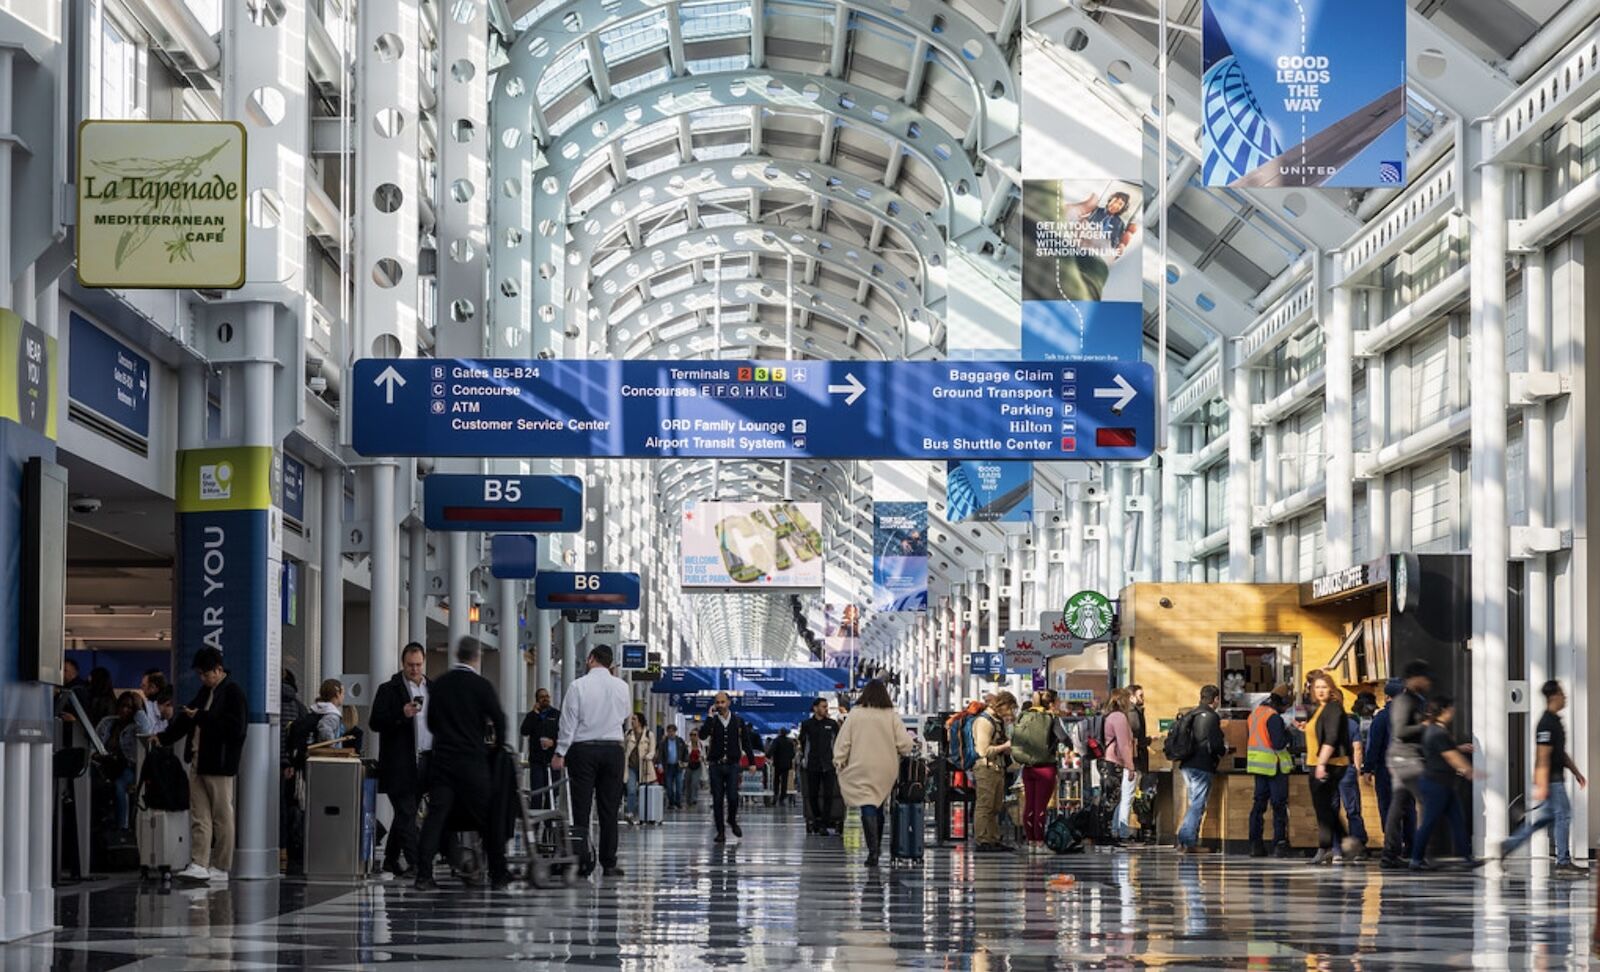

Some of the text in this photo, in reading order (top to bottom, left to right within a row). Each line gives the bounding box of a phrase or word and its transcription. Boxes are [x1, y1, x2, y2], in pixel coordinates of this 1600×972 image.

[1276, 56, 1329, 69] GOOD
[1276, 70, 1331, 83] LEADS
[1287, 84, 1319, 97] THE
[1283, 98, 1323, 112] WAY
[1279, 166, 1338, 175] UNITED
[84, 174, 238, 209] La Tapenade
[94, 215, 224, 225] MEDITERRANEAN
[1036, 221, 1102, 231] GET IN TOUCH
[185, 227, 226, 242] CAFÉ
[1036, 230, 1112, 239] WITH AN AGENT
[1036, 239, 1081, 248] WITHOUT
[1036, 248, 1121, 257] STANDING IN LINE
[434, 367, 540, 379] B Gates B5-B24
[670, 368, 783, 380] Terminals 2 3 5
[950, 369, 1054, 383] Baggage Claim
[433, 384, 521, 395] C Concourse
[621, 385, 783, 397] Concourses E F G H K L
[932, 386, 1053, 400] Ground Transport
[452, 401, 481, 412] ATM
[1001, 403, 1073, 417] Parking P
[451, 419, 611, 430] Customer Service Center
[661, 419, 785, 433] ORD Family Lounge
[1009, 420, 1052, 433] Hilton
[645, 437, 785, 451] Airport Transit System
[923, 438, 1053, 449] Bus Shuttle Center
[484, 479, 521, 502] B5
[684, 555, 719, 565] WELCOME
[684, 565, 694, 574] TO
[574, 574, 600, 590] B6
[684, 575, 708, 583] PUBLIC
[203, 526, 225, 656] AR YOU
[1041, 632, 1071, 641] SMOOT
